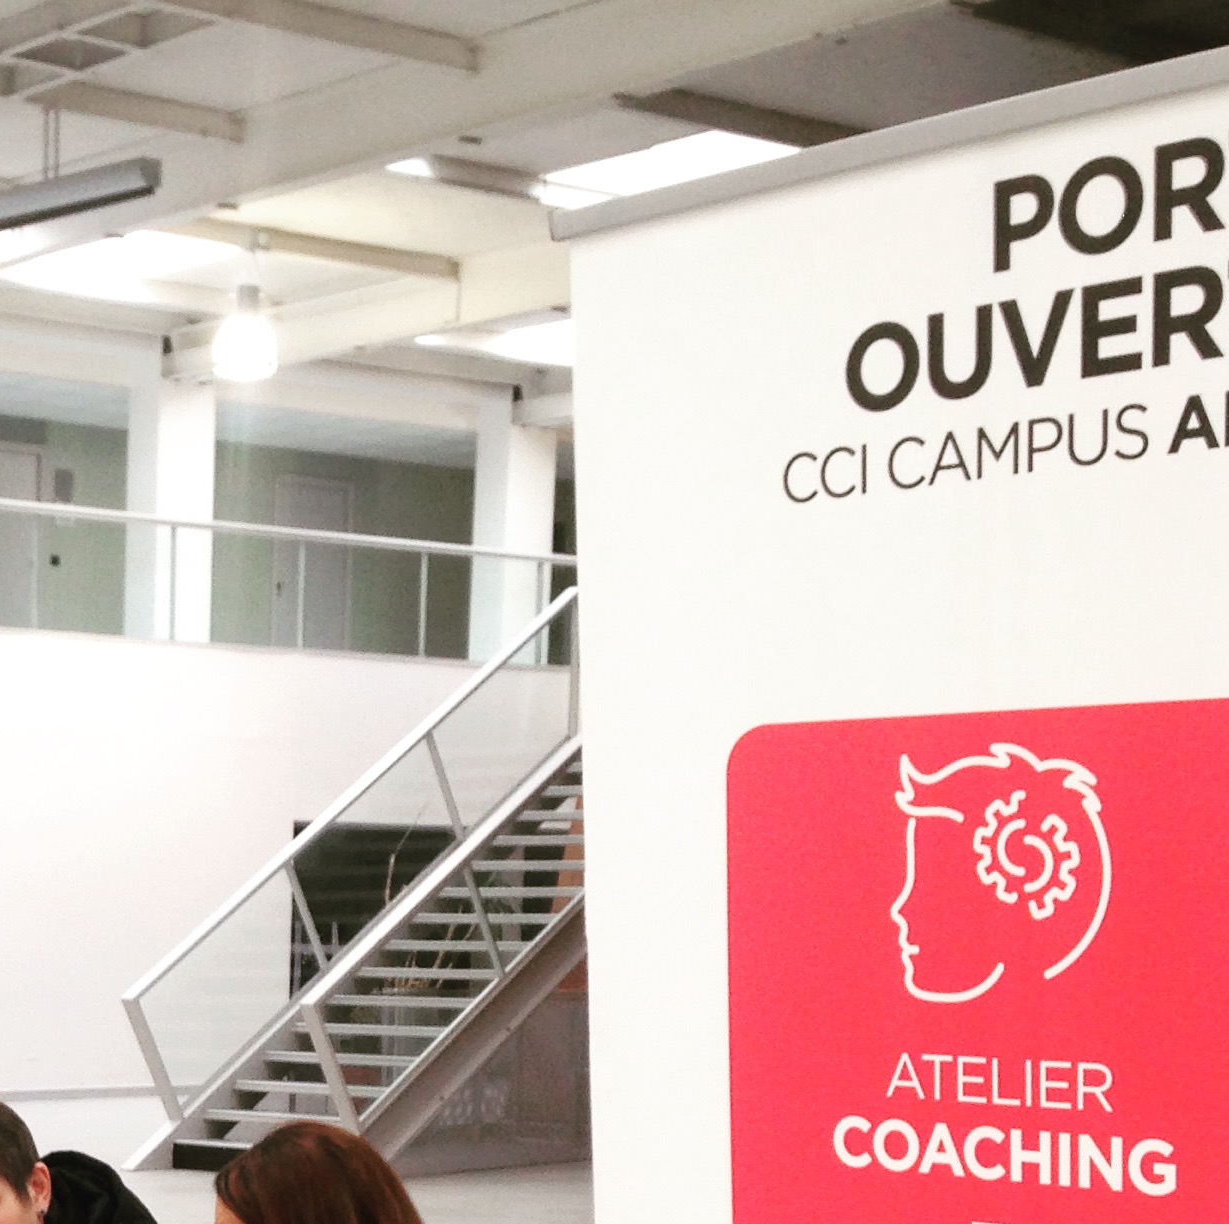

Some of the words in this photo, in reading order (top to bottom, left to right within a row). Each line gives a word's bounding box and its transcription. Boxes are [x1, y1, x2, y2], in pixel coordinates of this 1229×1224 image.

[993, 136, 1229, 274] POR
[845, 264, 1229, 413] OUVER
[782, 443, 868, 504] CCI
[887, 403, 1150, 490] CAMPUS
[1167, 391, 1229, 455] A
[886, 1051, 1114, 1113] ATELIER
[832, 1115, 1178, 1197] COACHING
